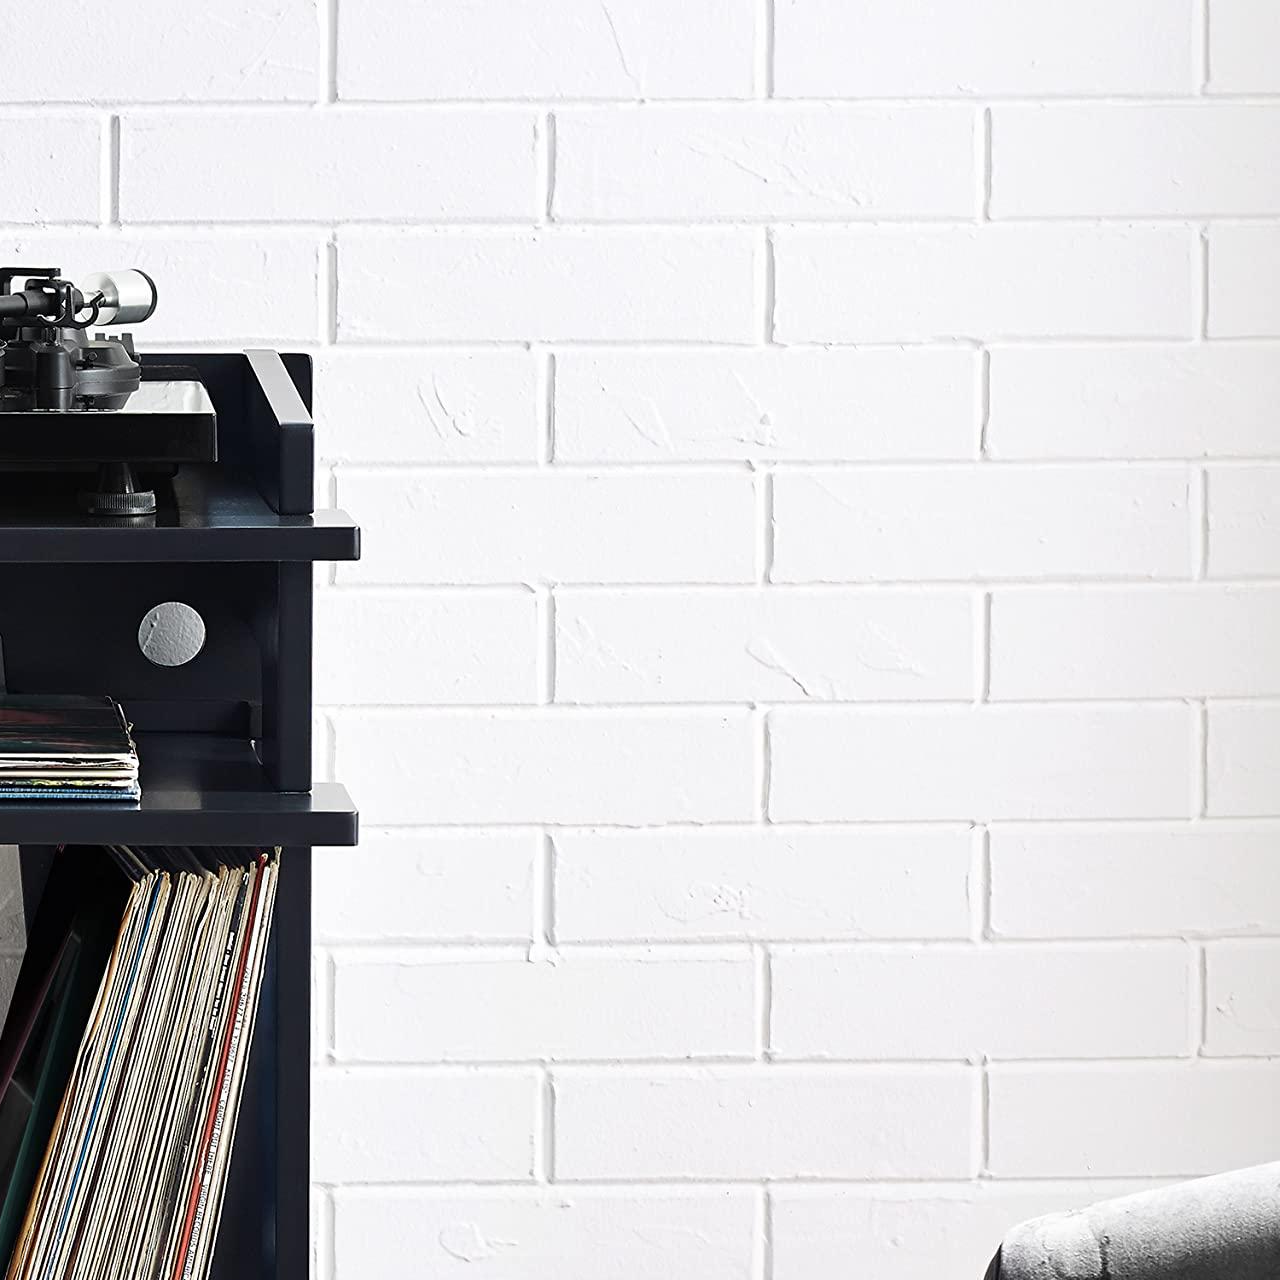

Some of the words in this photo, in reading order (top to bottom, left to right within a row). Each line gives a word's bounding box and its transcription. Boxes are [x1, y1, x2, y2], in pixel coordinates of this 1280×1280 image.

[213, 1099, 225, 1130] CAUGHT
[210, 1132, 218, 1147] OUT
[204, 1150, 215, 1175] THERE
[197, 1183, 208, 1210] VIRGIN
[190, 1211, 203, 1248] RECORDS
